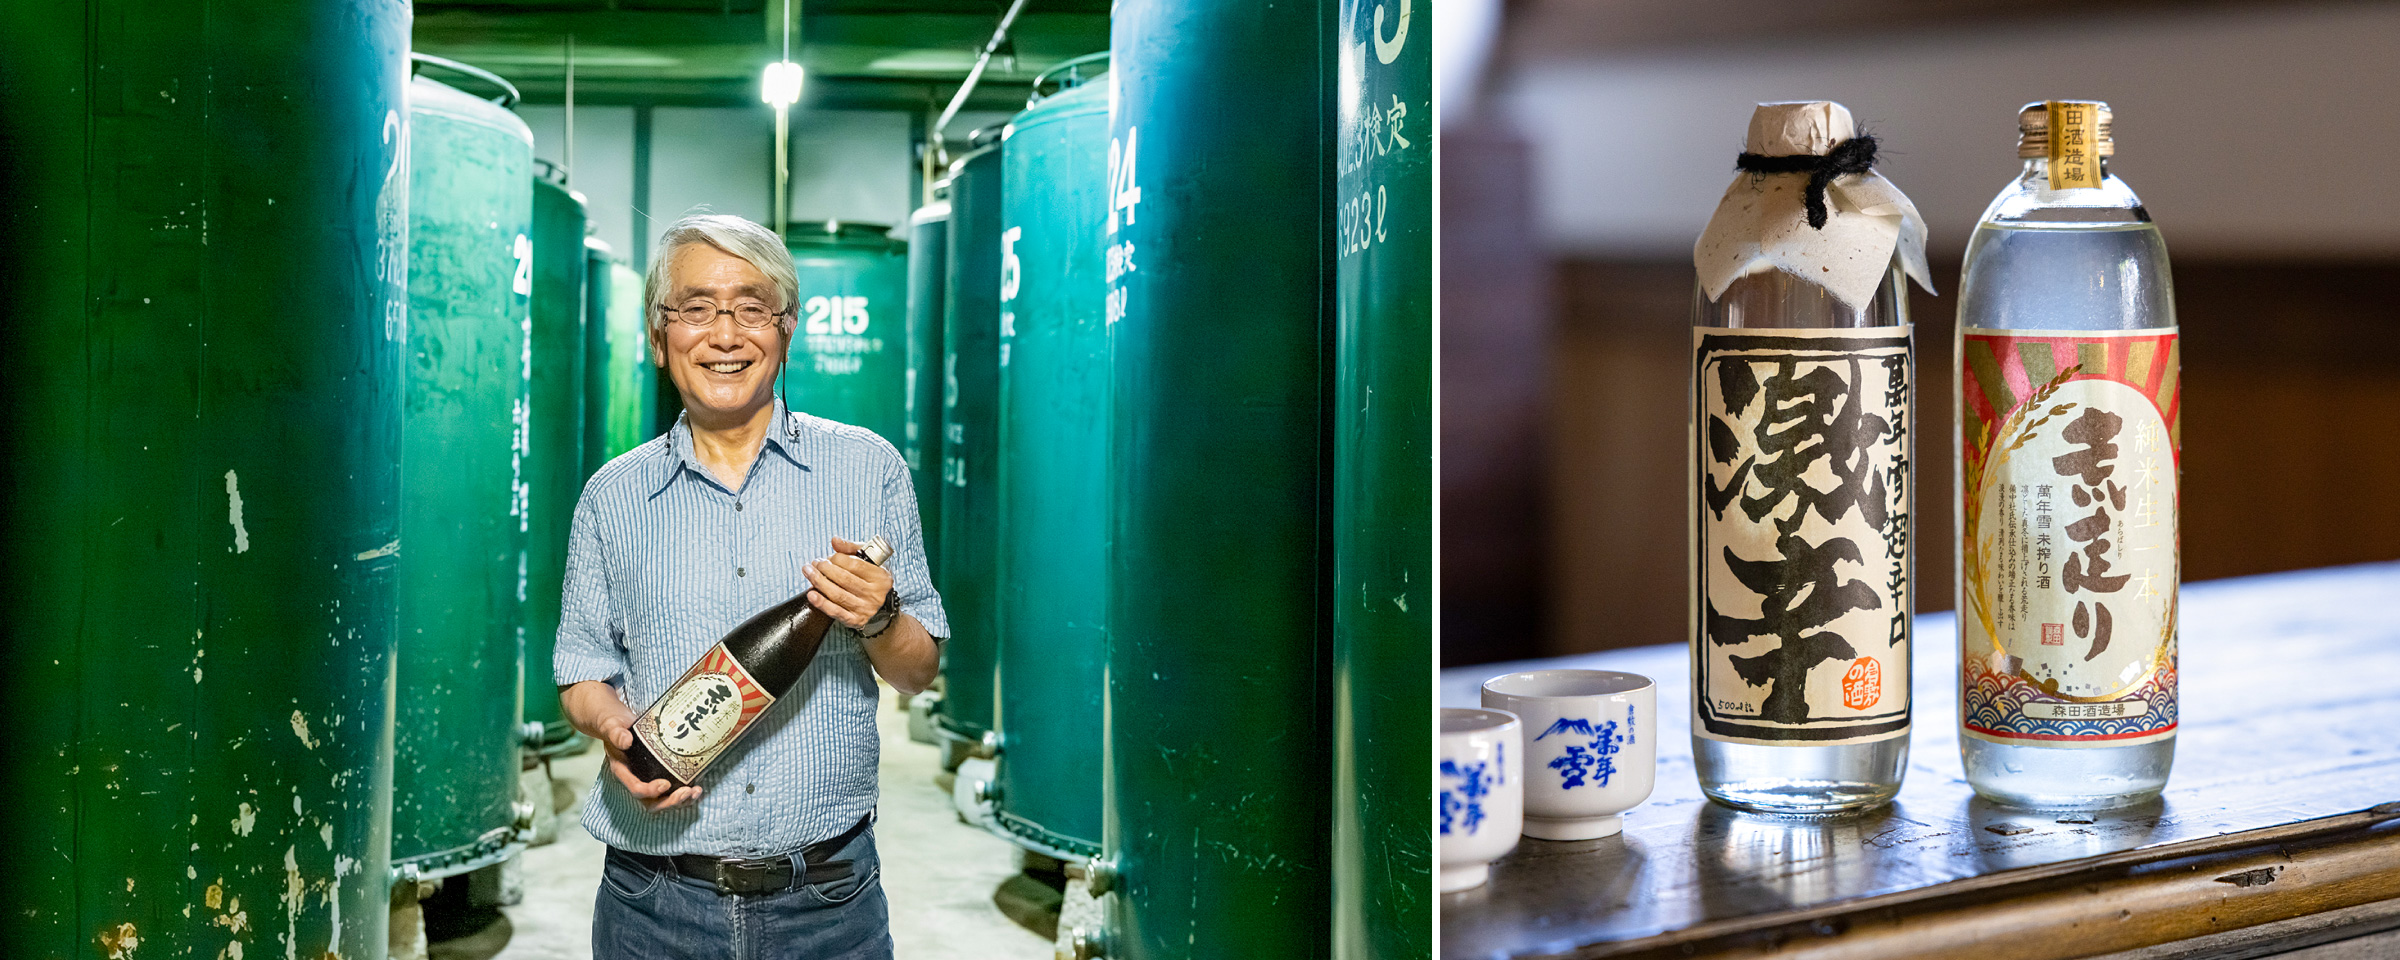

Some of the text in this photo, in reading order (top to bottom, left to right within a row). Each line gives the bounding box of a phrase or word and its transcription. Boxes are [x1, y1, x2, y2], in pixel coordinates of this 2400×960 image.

[804, 295, 870, 335] 215
[1705, 354, 1888, 724] 激辛
[2052, 407, 2131, 662] 荒走り
[2133, 419, 2160, 604] 純米生一本
[2051, 703, 2126, 718] 森田酒造場
